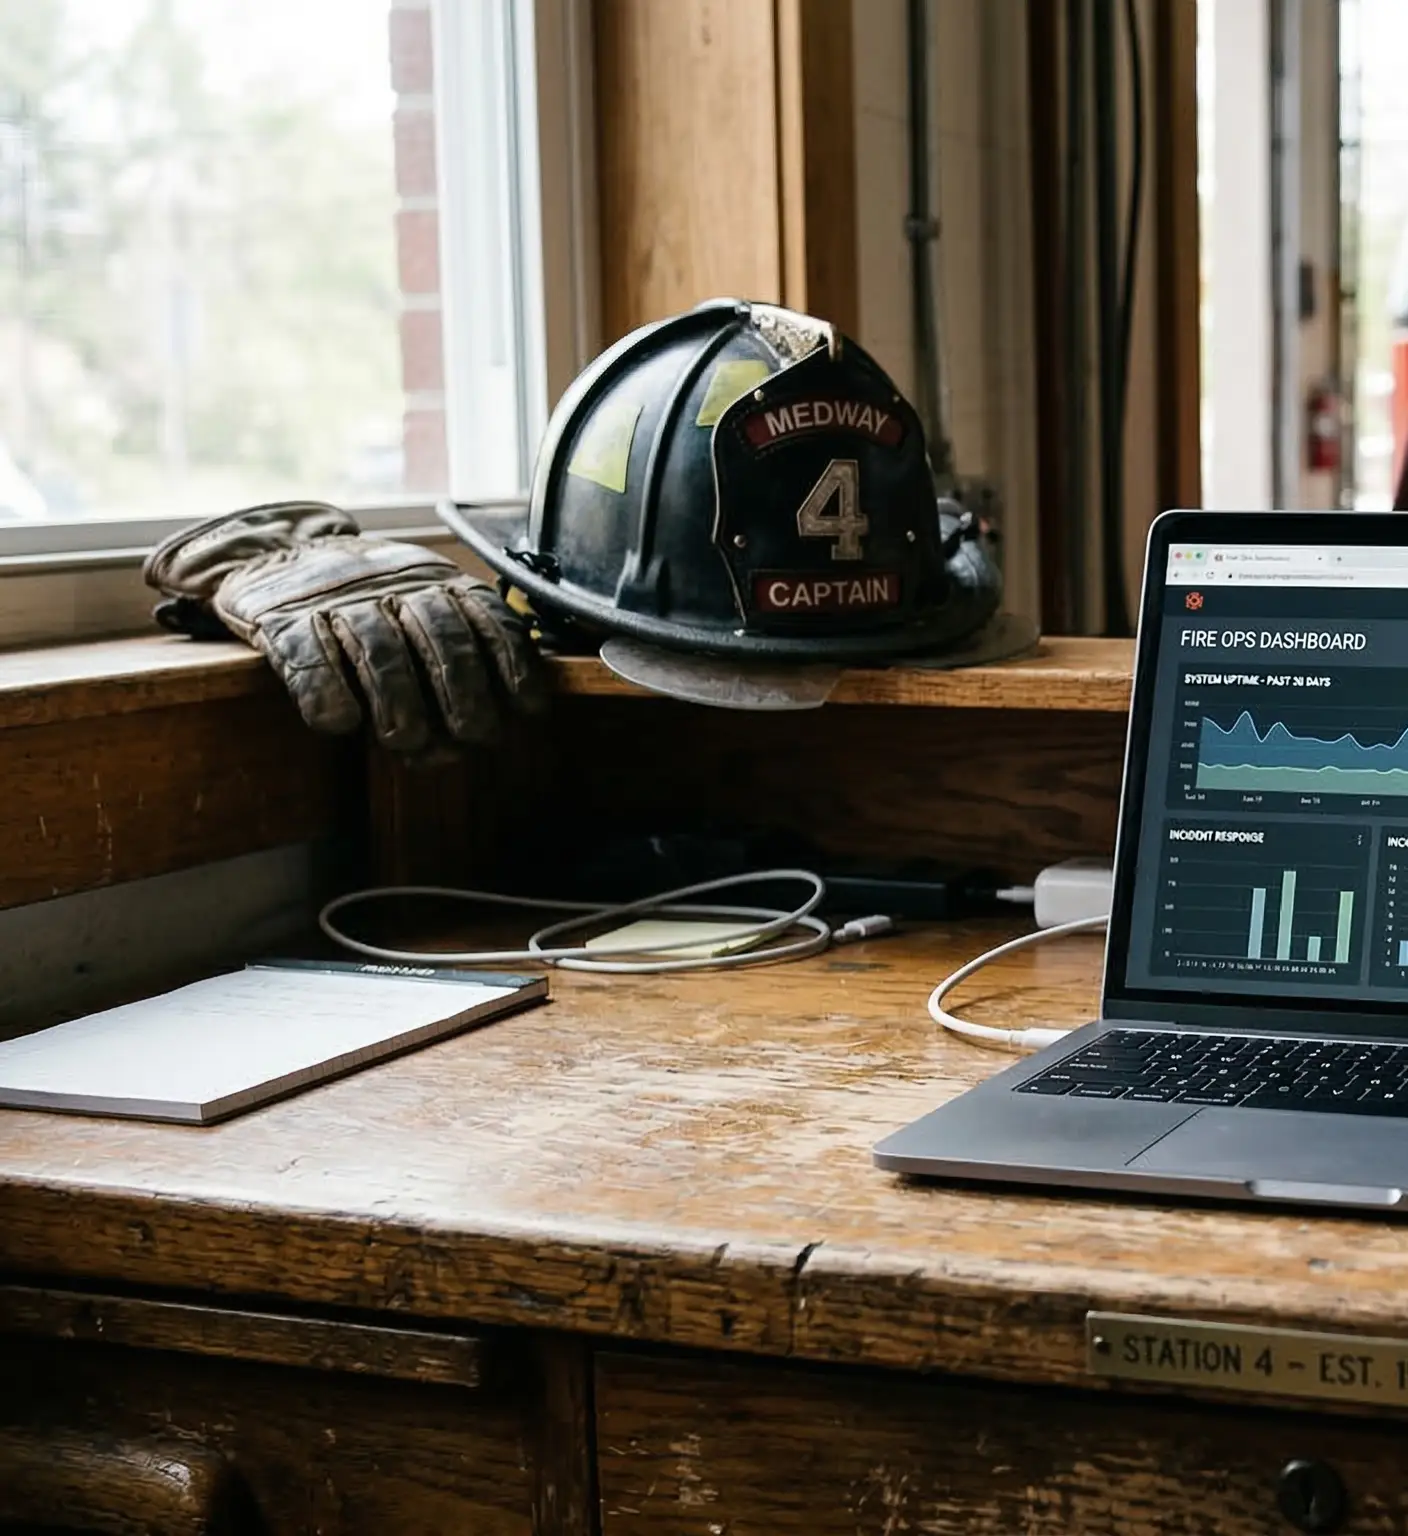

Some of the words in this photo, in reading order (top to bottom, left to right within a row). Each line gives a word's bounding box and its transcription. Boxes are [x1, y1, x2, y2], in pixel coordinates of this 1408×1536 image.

[764, 400, 889, 437] MEDWAY
[796, 459, 869, 560] 4
[768, 577, 889, 607] CAPTAIN
[1180, 629, 1218, 648] FIRE
[1221, 630, 1257, 649] OPS
[1259, 631, 1367, 651] DASHBOARD
[1184, 673, 1222, 685] SYSTEM
[1223, 674, 1260, 686] UPTIME
[1266, 675, 1291, 687] PAST
[1305, 676, 1331, 688] DAYS
[1122, 1334, 1242, 1374] STATION
[1254, 1347, 1274, 1378] 4
[1318, 1352, 1384, 1390] EST.
